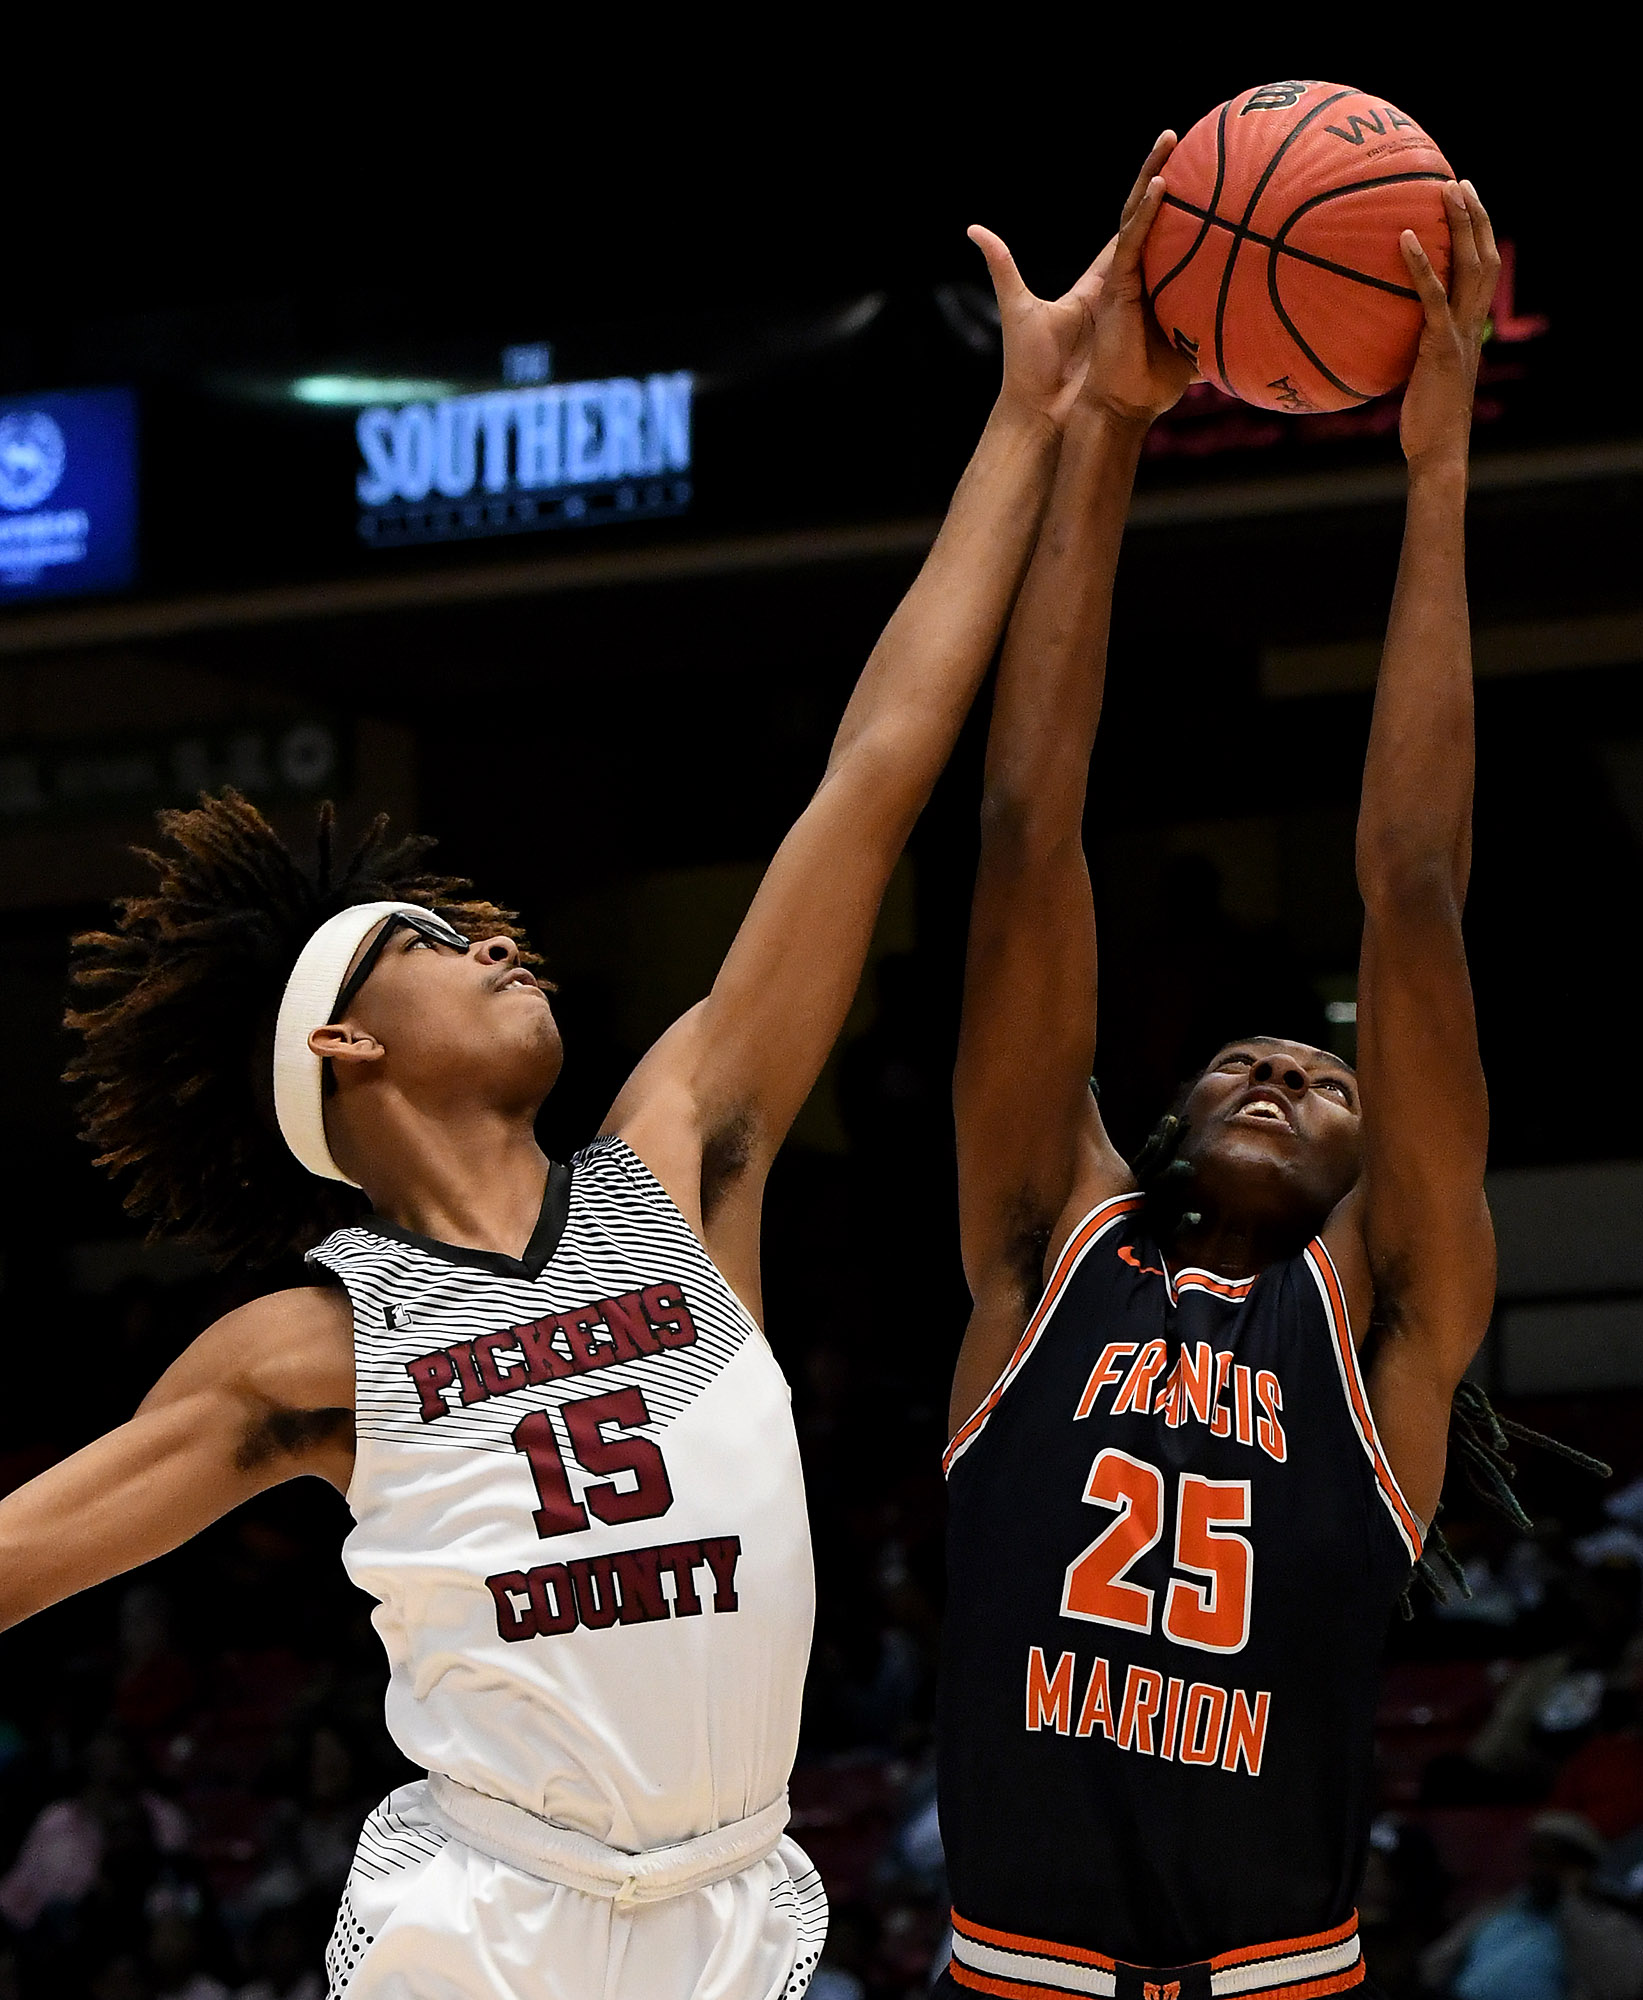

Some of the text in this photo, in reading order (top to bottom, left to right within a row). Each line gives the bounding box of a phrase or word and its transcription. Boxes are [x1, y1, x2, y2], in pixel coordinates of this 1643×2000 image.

[356, 371, 693, 505] SOUTHERN
[405, 1281, 700, 1424] PICKENS
[1073, 1338, 1288, 1463] FRANCIS
[511, 1385, 675, 1540] 15
[485, 1534, 743, 1643] COUNTY
[1058, 1447, 1254, 1655] 25
[1025, 1645, 1272, 1777] MARION
